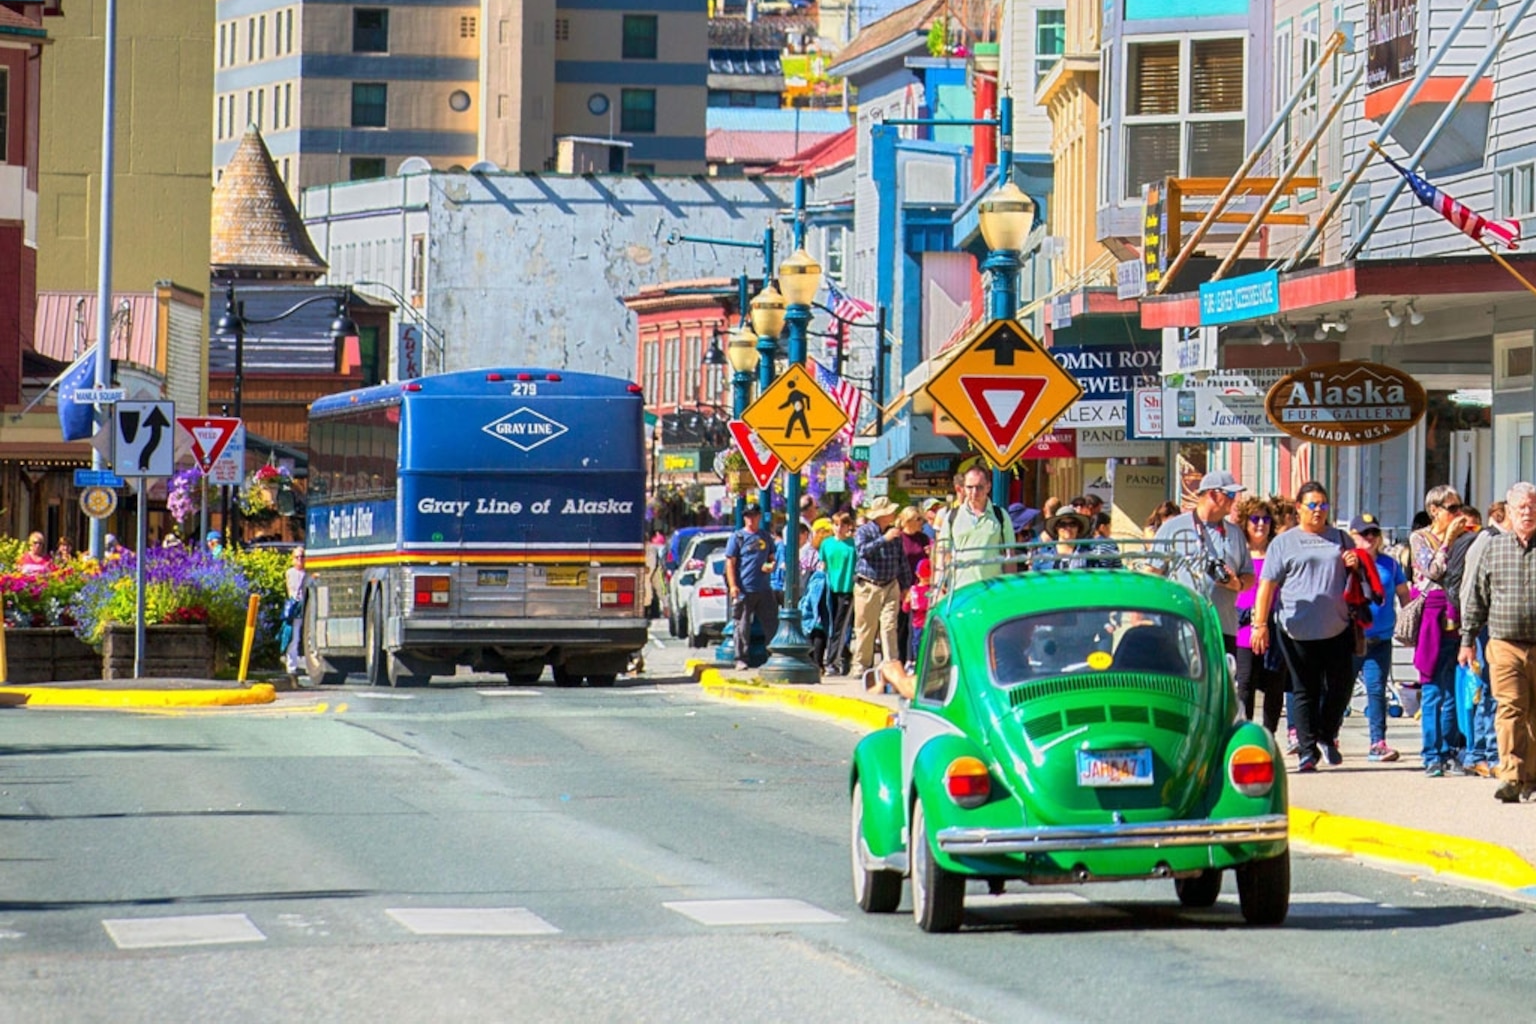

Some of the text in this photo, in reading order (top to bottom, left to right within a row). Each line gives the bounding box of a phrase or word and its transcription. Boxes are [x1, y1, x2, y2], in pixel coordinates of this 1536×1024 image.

[1053, 350, 1115, 370] OMNI
[511, 383, 537, 396] 279
[1286, 379, 1406, 406] Alaska
[1057, 405, 1103, 422] ALEX
[1211, 409, 1262, 427] Jasmine
[1288, 407, 1406, 421] FUR GALLERY
[496, 422, 553, 435] GRAY LINE
[1082, 429, 1126, 442] PAND
[1301, 424, 1351, 442] CANADA
[417, 497, 634, 518] Gray Line of Alaska
